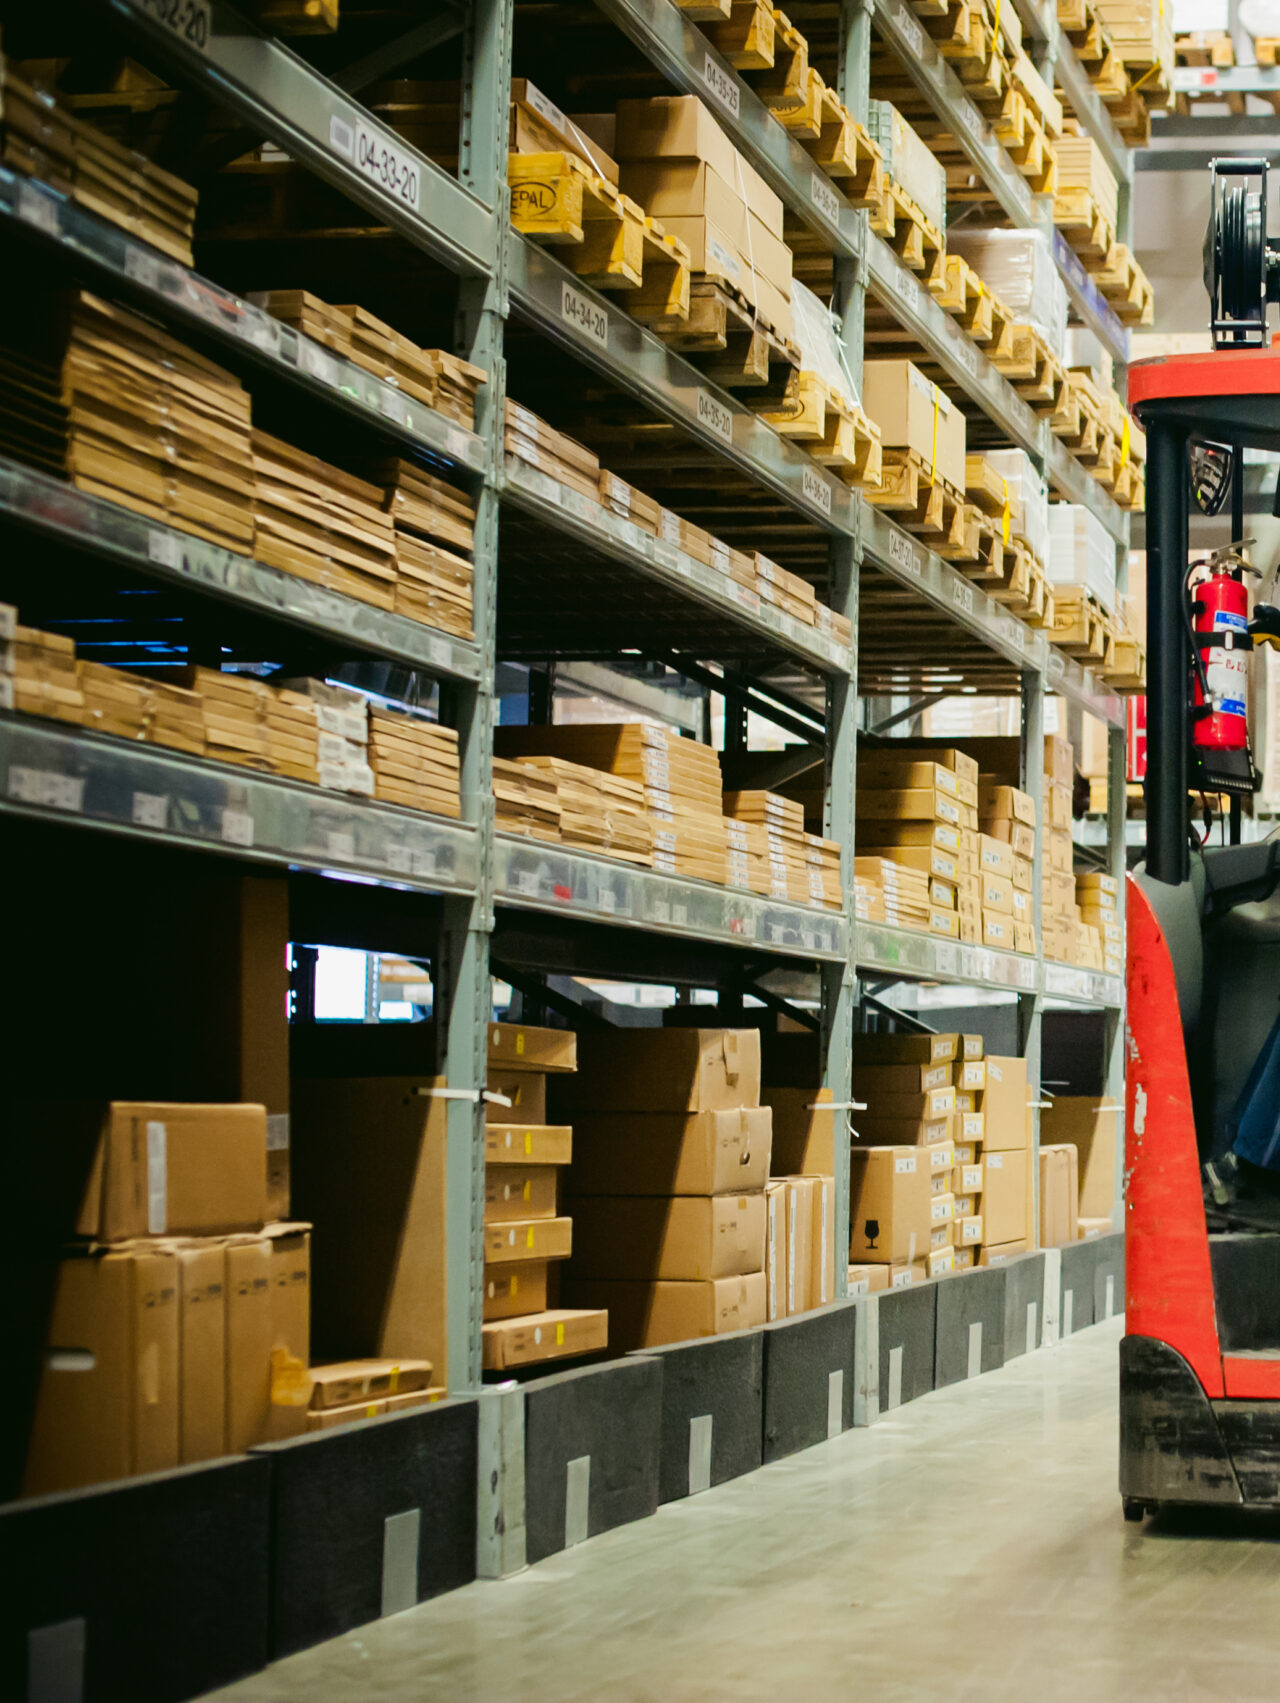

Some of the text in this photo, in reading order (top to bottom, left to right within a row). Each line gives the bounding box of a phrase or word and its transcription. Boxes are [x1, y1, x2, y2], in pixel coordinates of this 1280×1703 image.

[707, 63, 737, 110] 04-35-25
[359, 133, 416, 204] 04-33-20
[511, 190, 549, 209] EPAL
[565, 292, 605, 340] 04-34-20
[699, 395, 731, 436] 04-35-20
[805, 472, 829, 509] 04-36-20
